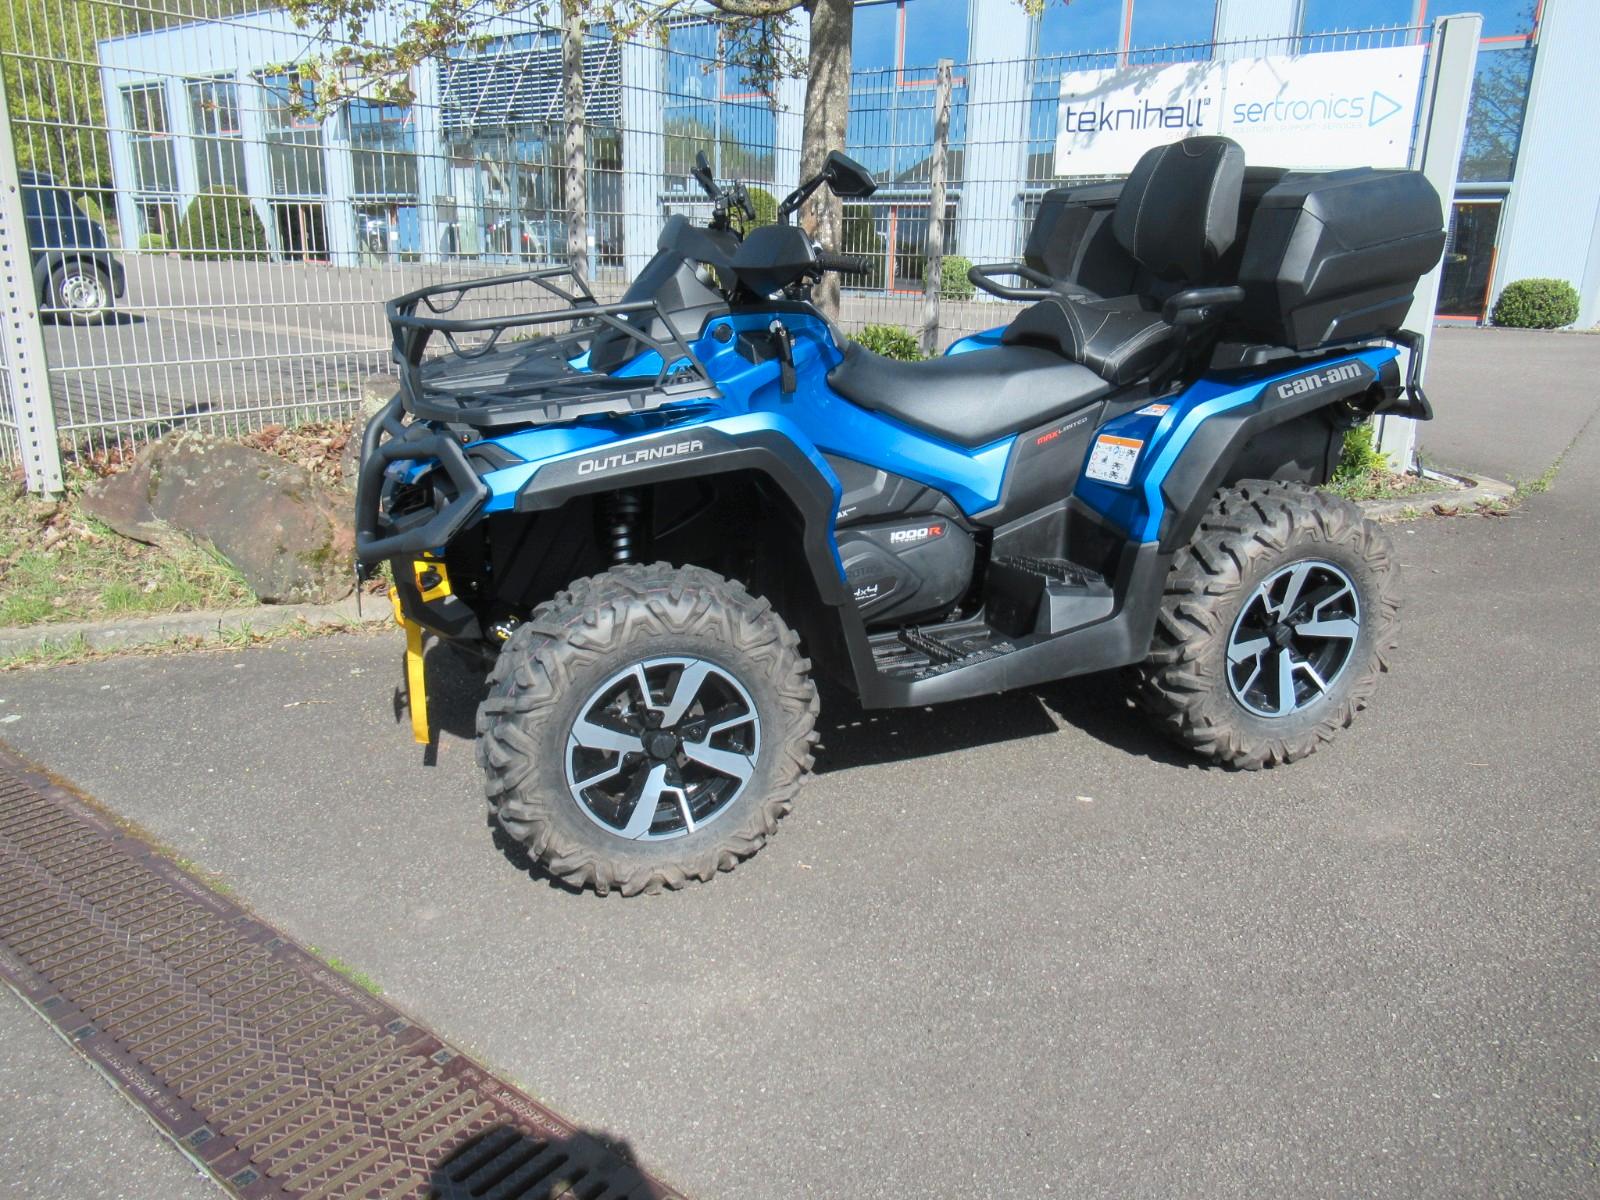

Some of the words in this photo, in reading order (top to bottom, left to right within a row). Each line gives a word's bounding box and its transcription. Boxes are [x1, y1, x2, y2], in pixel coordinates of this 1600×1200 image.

[1233, 94, 1364, 123] sertronics
[1277, 364, 1362, 399] can-am
[578, 441, 703, 475] OUTLANDER
[891, 527, 941, 543] 1000R
